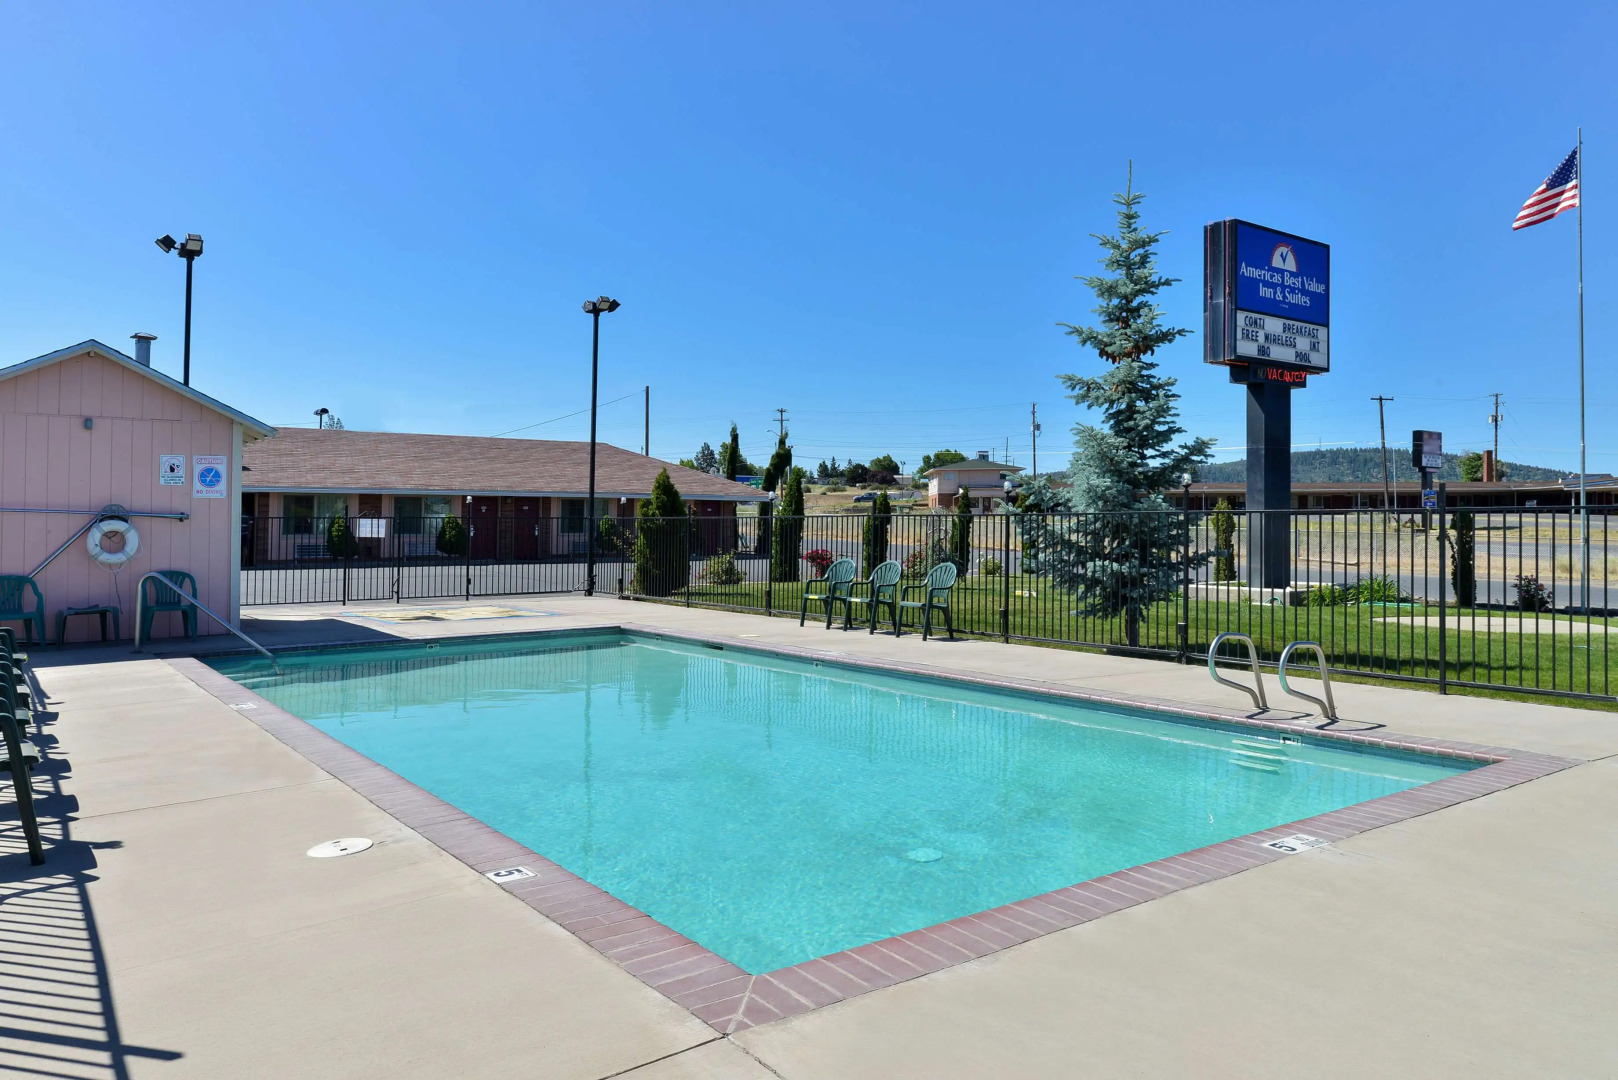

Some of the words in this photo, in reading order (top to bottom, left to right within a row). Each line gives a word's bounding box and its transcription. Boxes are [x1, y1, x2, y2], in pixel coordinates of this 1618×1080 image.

[1240, 261, 1282, 284] Americas
[1284, 272, 1302, 289] Best
[1304, 277, 1326, 294] Value
[1259, 283, 1274, 299] Inn
[1275, 287, 1283, 301] &
[1285, 288, 1310, 307] Suites
[1244, 315, 1265, 330] CONTI
[1282, 322, 1319, 339] BREAKFAST
[1241, 328, 1259, 343] FREE
[1264, 332, 1297, 348] WIRELESS
[1257, 344, 1271, 358] HBO
[1295, 350, 1312, 364] POOL
[1266, 367, 1307, 383] VACANCY
[1267, 842, 1298, 852] 5
[493, 868, 524, 878] 5
